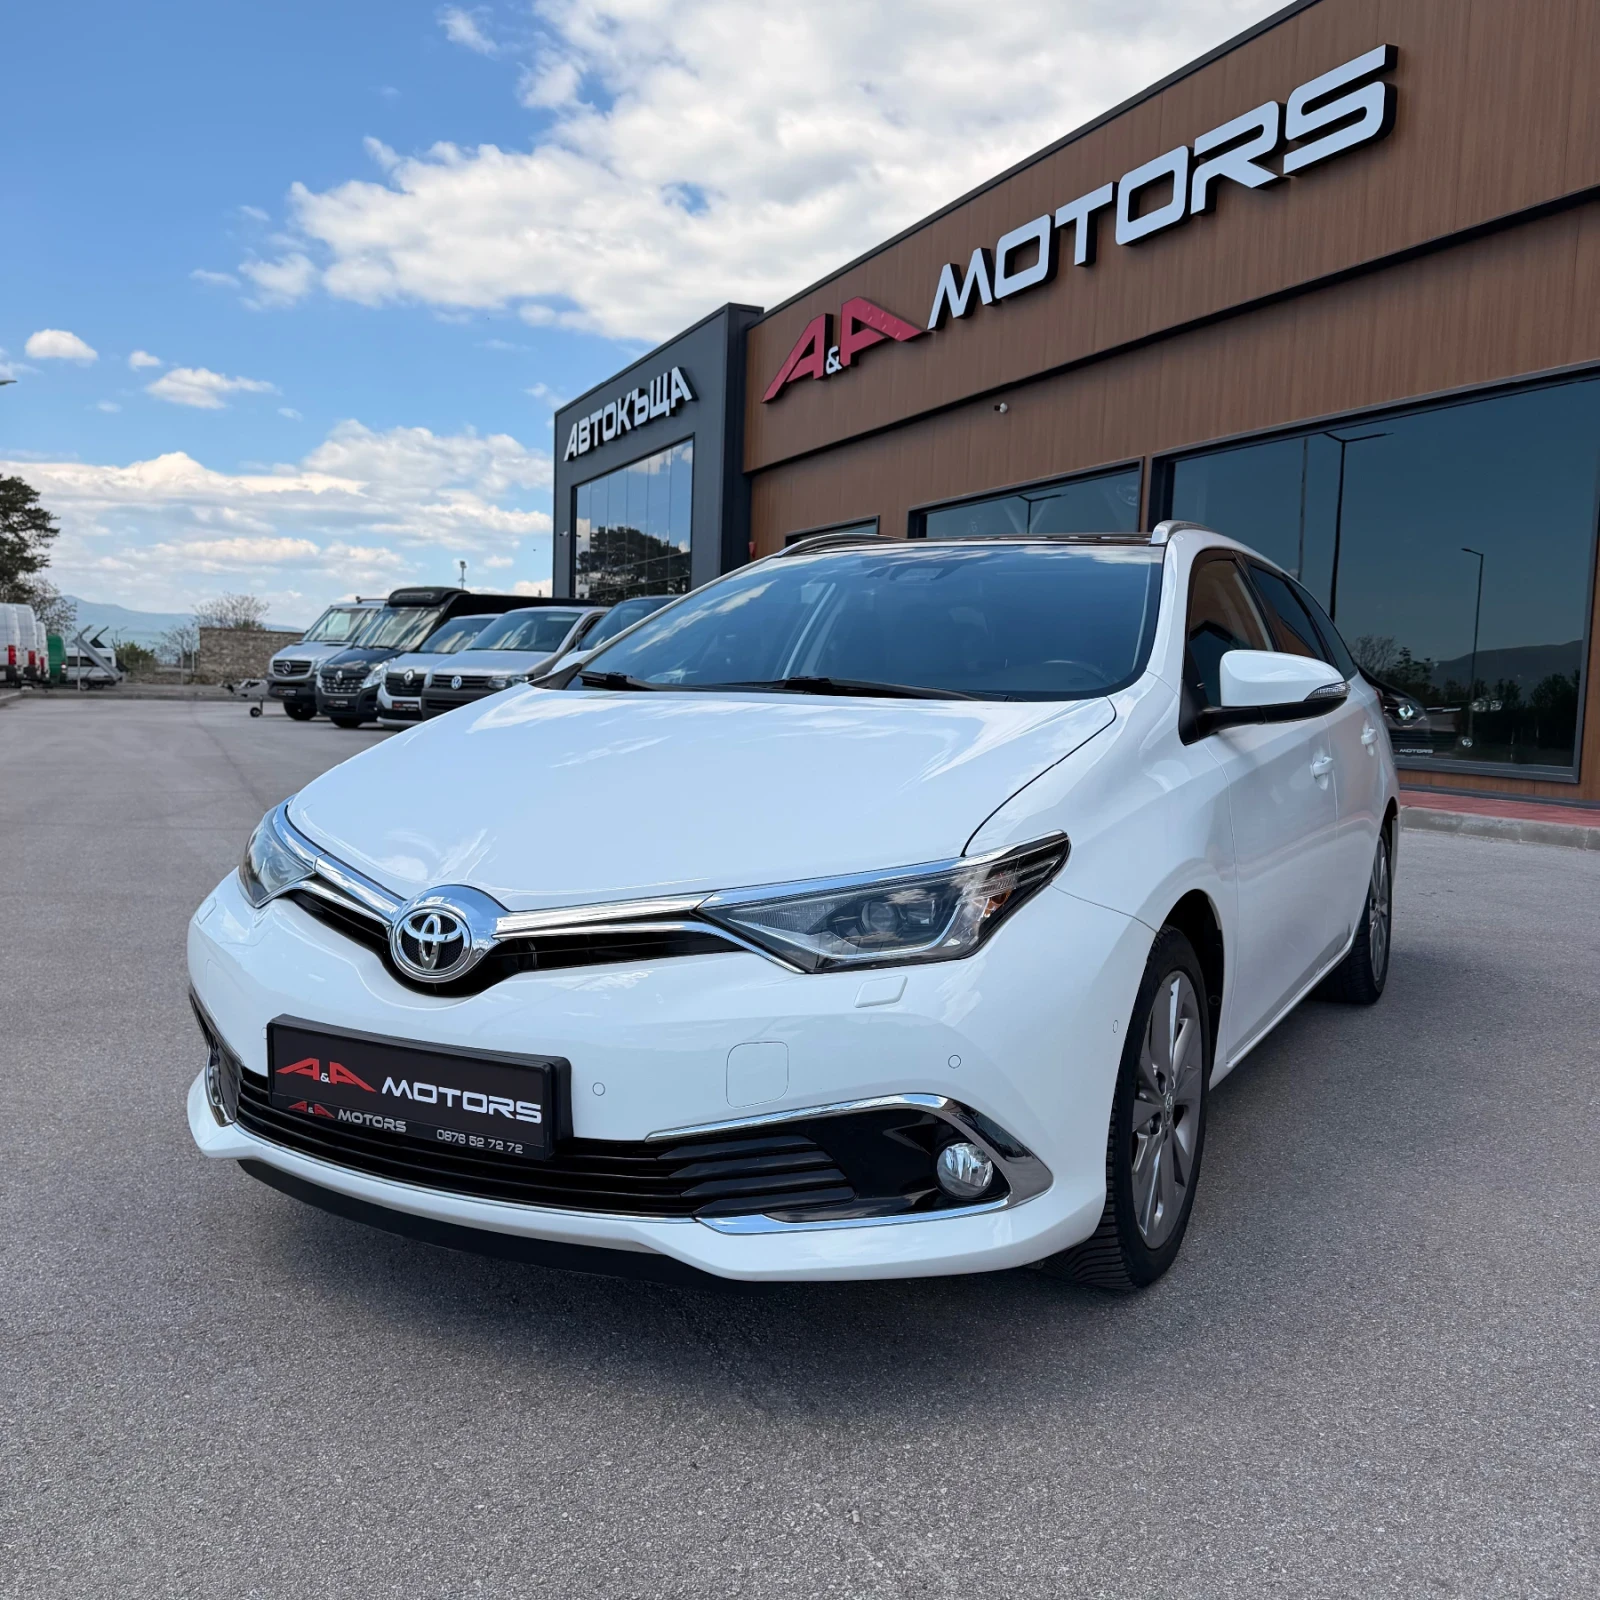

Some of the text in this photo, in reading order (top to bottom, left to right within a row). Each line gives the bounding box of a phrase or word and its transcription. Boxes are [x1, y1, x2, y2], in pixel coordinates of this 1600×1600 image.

[762, 43, 1393, 403] A&A MOTORS
[563, 366, 694, 462] АВТОКЪЩА
[276, 1057, 542, 1124] A&A MOTORS
[288, 1100, 407, 1133] A&A MOTORS
[487, 1138, 504, 1151] 72
[506, 1142, 524, 1155] 72
